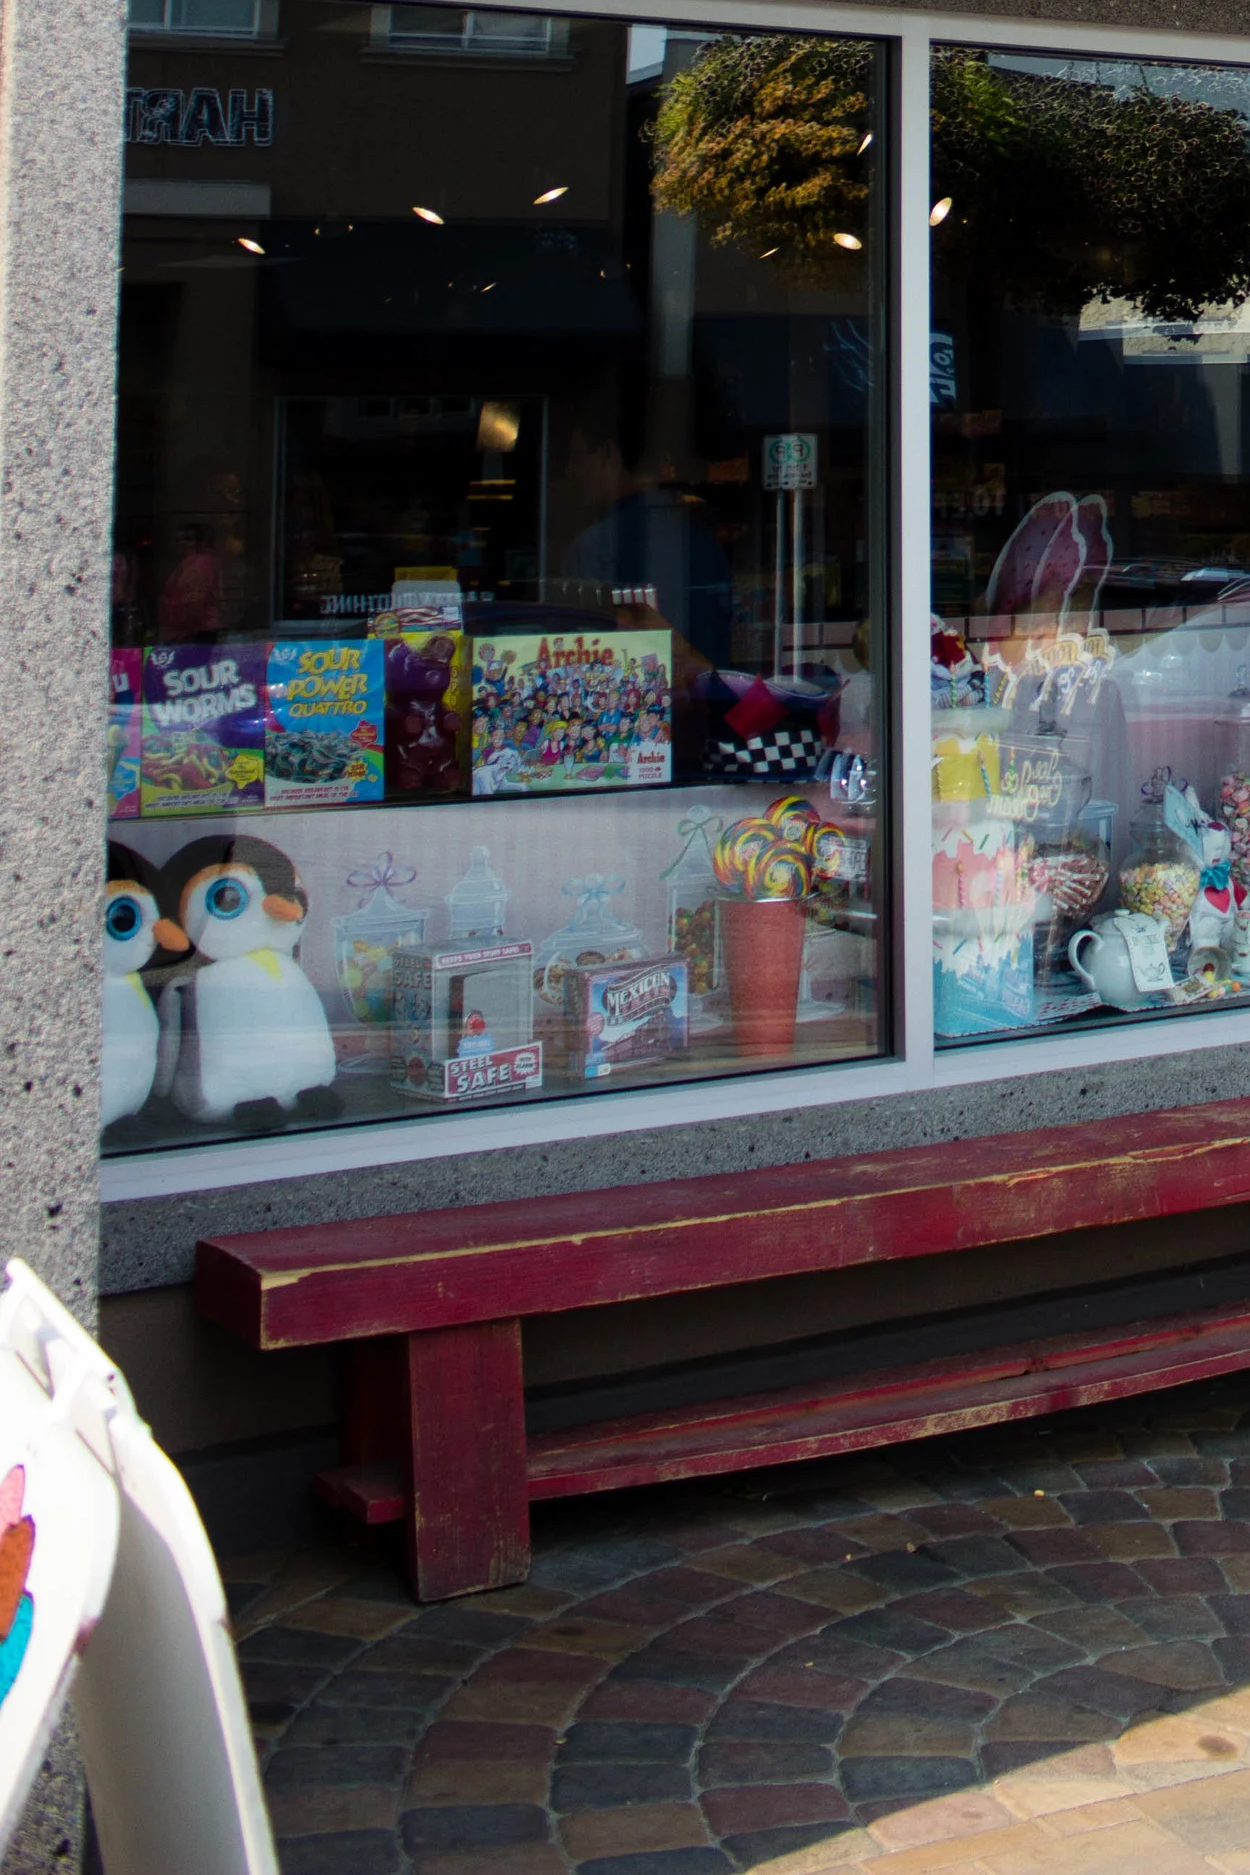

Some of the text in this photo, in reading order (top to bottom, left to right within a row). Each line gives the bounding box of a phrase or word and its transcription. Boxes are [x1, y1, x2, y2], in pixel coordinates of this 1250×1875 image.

[298, 647, 361, 674] SOUR
[537, 636, 614, 666] Archie
[163, 659, 240, 696] SOUR
[287, 673, 369, 701] POWER
[152, 683, 258, 725] WORMS
[289, 700, 367, 717] QUATTRO
[637, 751, 665, 764] Archie
[450, 1055, 493, 1076] STEEL
[457, 1063, 511, 1093] SAFE
